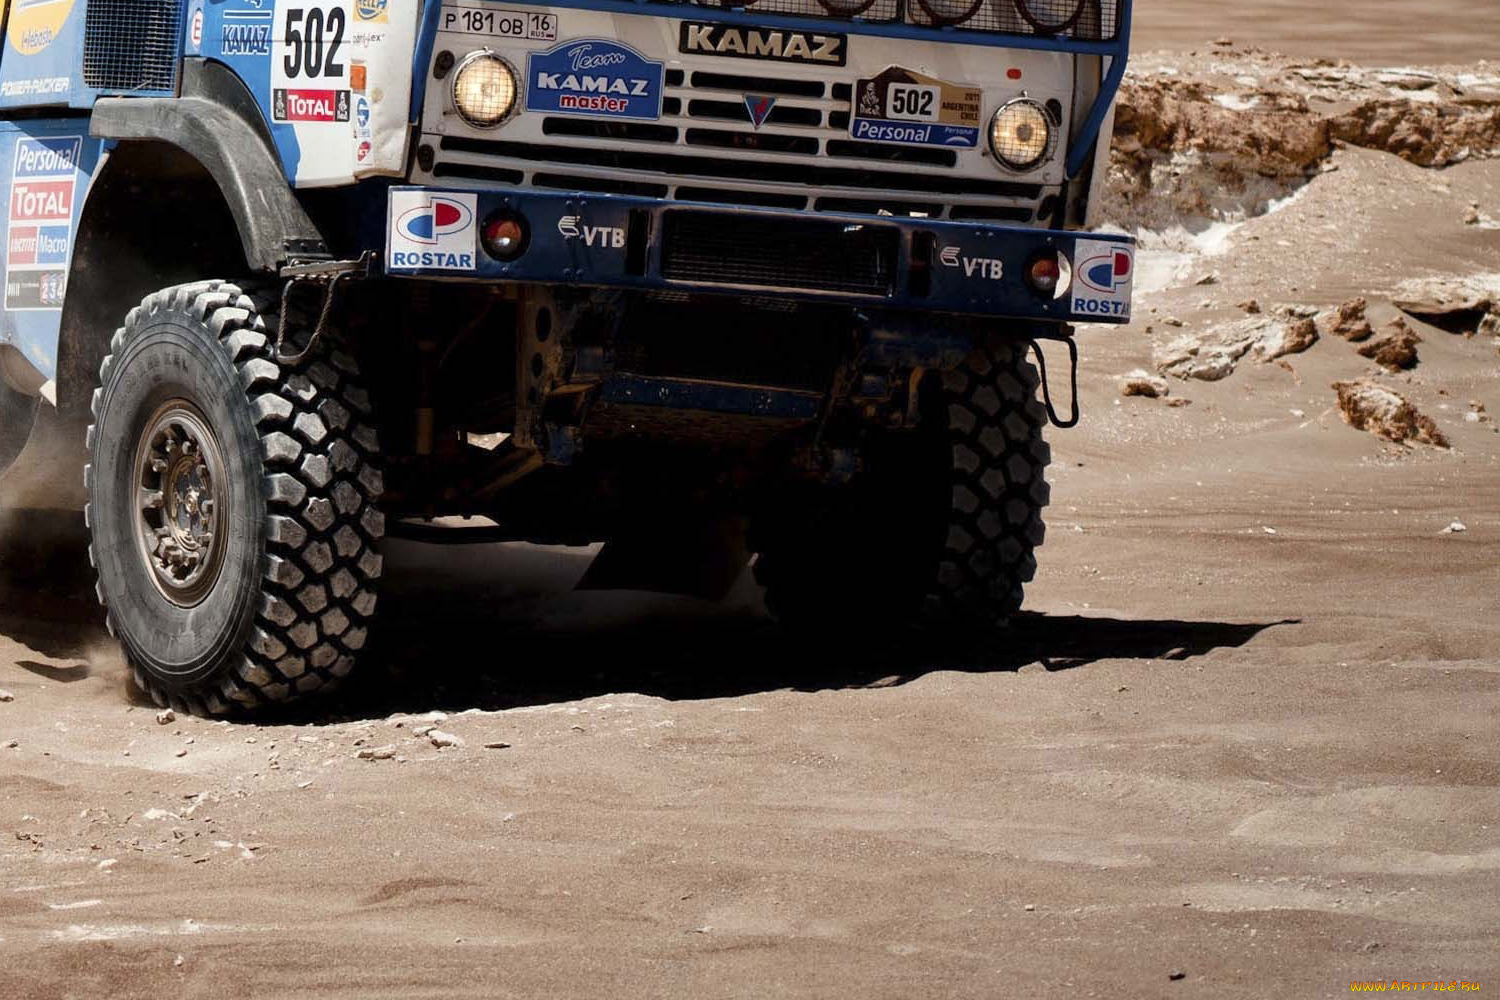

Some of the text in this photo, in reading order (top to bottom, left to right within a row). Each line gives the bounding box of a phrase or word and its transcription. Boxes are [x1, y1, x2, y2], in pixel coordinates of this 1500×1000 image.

[462, 10, 494, 33] 181
[531, 15, 550, 31] 16
[221, 23, 270, 55] KAMAZ
[283, 6, 346, 80] 502
[530, 30, 545, 38] RUS
[687, 25, 841, 62] KAMAZ
[567, 43, 626, 72] Team
[536, 71, 650, 97] KAMAZ
[287, 94, 334, 116] TOTAL
[559, 93, 629, 113] master
[891, 88, 934, 116] 502
[857, 121, 932, 143] Personal
[17, 141, 80, 173] Personal
[13, 185, 69, 217] TOTAL
[39, 234, 67, 254] Macro
[584, 225, 626, 248] VTB
[393, 251, 472, 268] ROSTAR
[963, 257, 1004, 280] VTB
